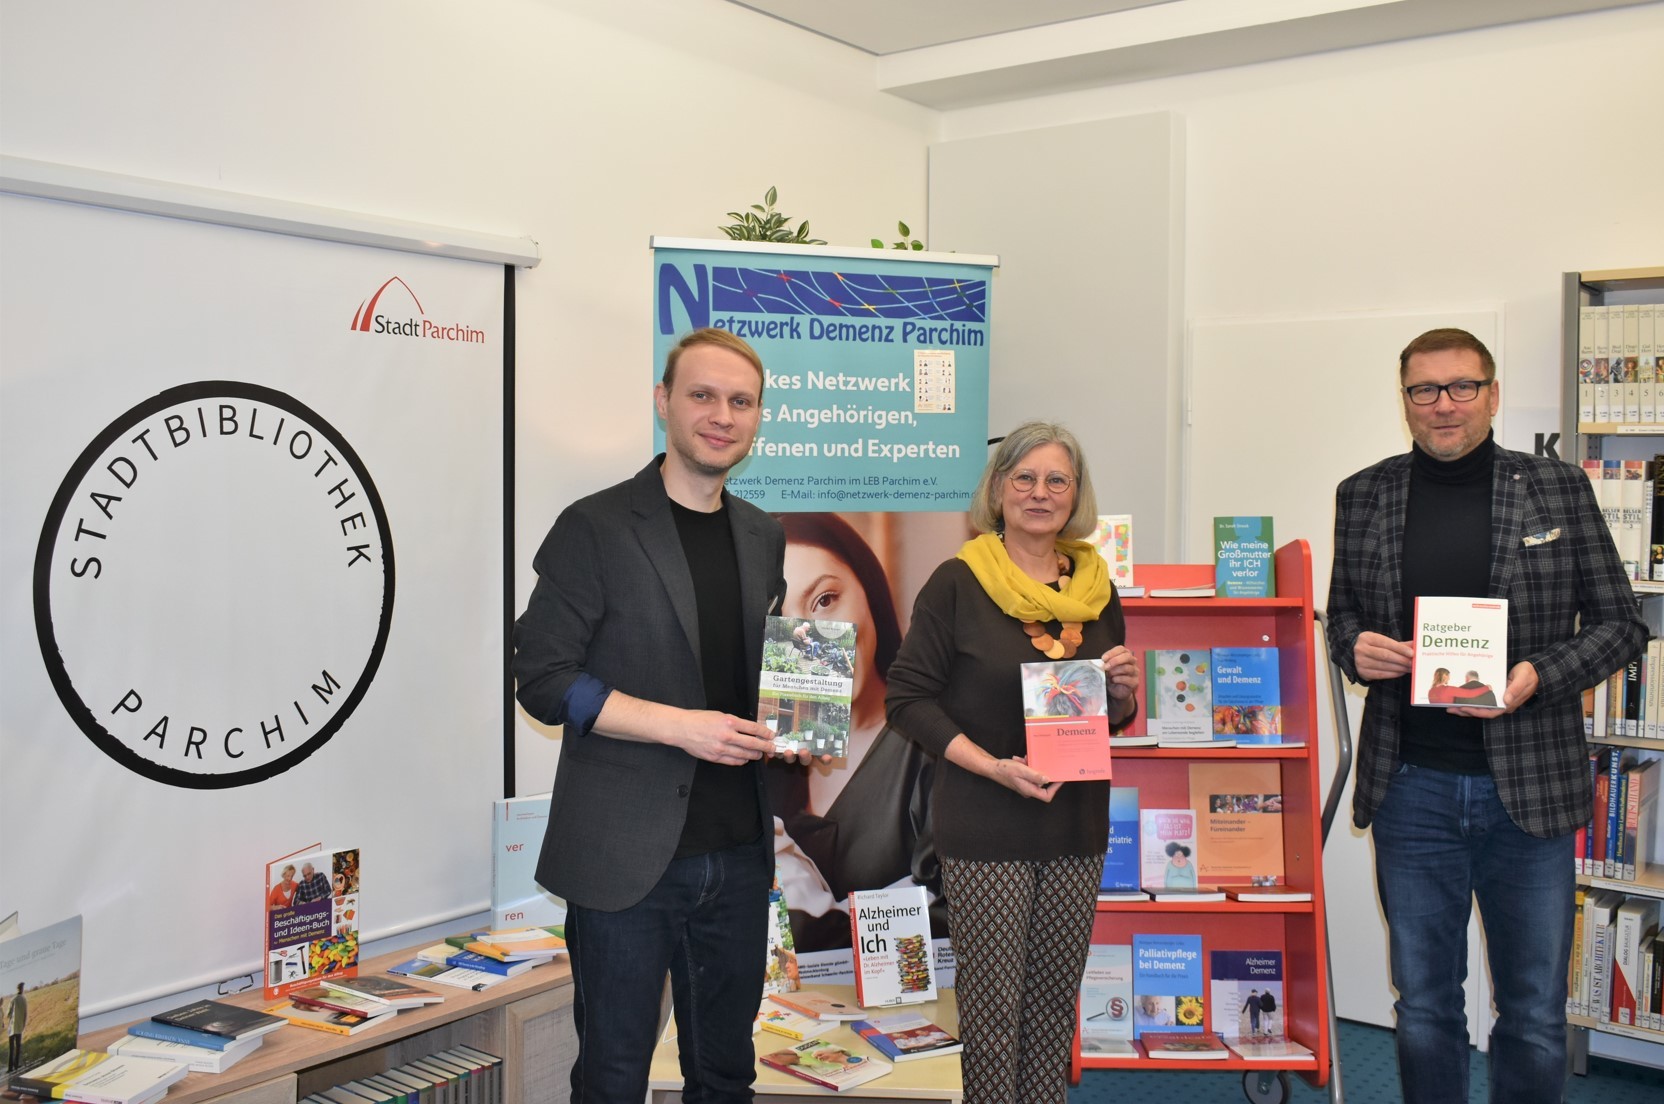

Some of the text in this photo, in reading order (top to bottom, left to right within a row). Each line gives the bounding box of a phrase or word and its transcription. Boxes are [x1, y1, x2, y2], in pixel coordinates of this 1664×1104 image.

[659, 263, 985, 347] Netzwerk Demenz Parchim
[374, 314, 485, 344] Stadt Parchim
[765, 369, 911, 392] kes Netzwerk
[1600, 390, 1605, 398] 2
[1614, 389, 1619, 397] 3
[1643, 389, 1649, 397] 5
[762, 404, 917, 429] s Angehörigen,
[823, 438, 863, 457] und
[868, 440, 960, 463] Experten
[723, 476, 762, 486] etzwerk
[764, 476, 804, 486] Demenz
[807, 476, 846, 486] Parchim
[848, 476, 861, 486] im
[863, 476, 880, 486] LEB
[882, 476, 921, 486] Parchim
[70, 404, 372, 580] STADTBIBLIOTHEK
[781, 489, 816, 500] E-Mail:
[817, 489, 977, 502] info@netzwerk-demenz-parchim.
[1220, 541, 1268, 549] Wie meine
[1217, 550, 1271, 558] Großmutter
[1229, 559, 1261, 568] ihr ICH
[1232, 569, 1258, 577] verlor
[1423, 622, 1472, 633] Ratgeber
[1422, 634, 1490, 649] Demenz
[1217, 665, 1243, 674] Gewalt
[773, 674, 843, 688] Gartengestaltung
[1217, 675, 1262, 684] und Demenz
[110, 669, 342, 759] PARCHIM
[1056, 727, 1097, 737] Demenz
[1108, 835, 1133, 844] eriatrie
[505, 843, 524, 852] ver
[505, 911, 524, 921] ren
[858, 905, 921, 920] Alzheimer
[274, 911, 329, 928] Beschäftigungs-
[274, 919, 330, 938] und Ideen-Buch
[867, 919, 890, 932] und
[861, 934, 887, 954] Ich
[1139, 948, 1197, 960] Palliativpflege
[1139, 960, 1186, 970] bei Demenz
[1245, 957, 1276, 966] Alzheimer
[1250, 966, 1276, 975] Demenz
